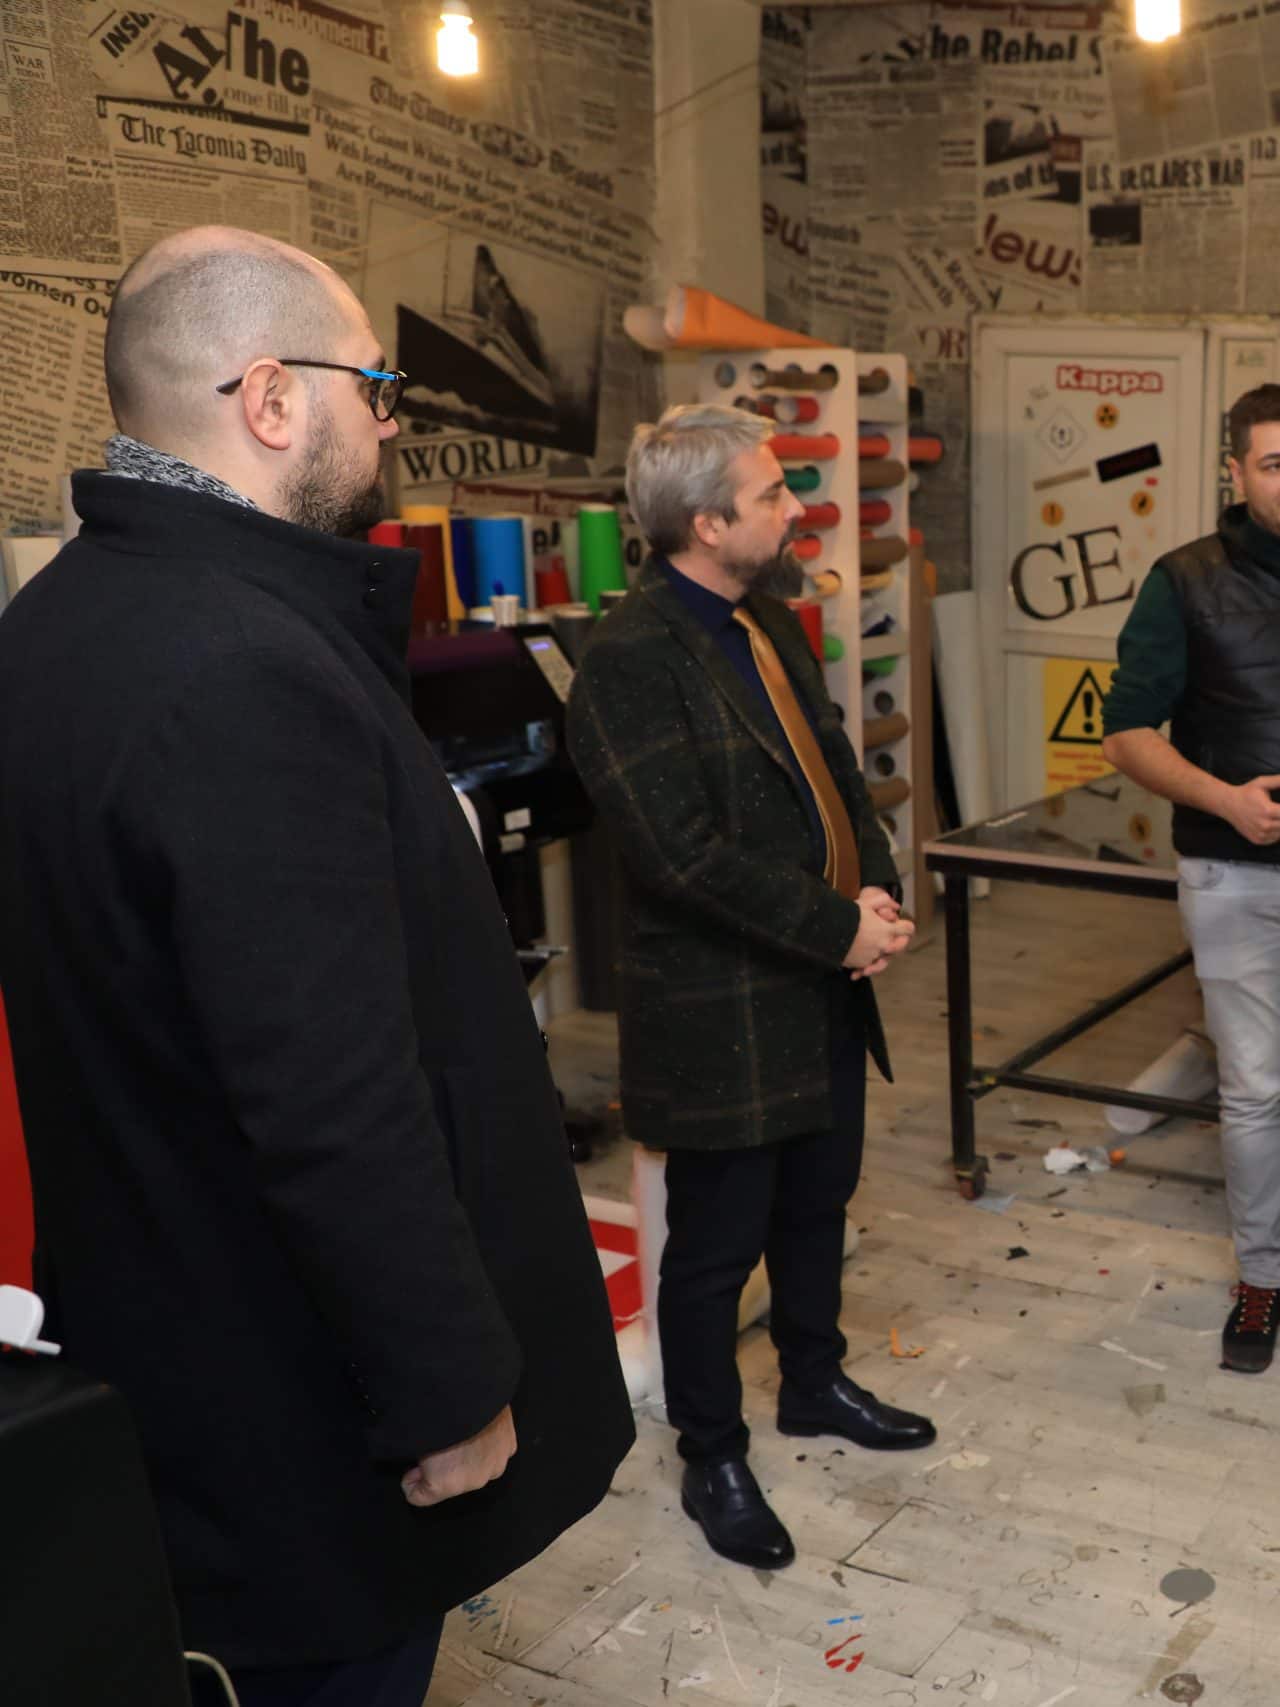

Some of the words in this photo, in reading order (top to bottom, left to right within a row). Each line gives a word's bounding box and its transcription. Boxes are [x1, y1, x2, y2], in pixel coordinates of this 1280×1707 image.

[12, 54, 45, 70] WAR
[117, 112, 166, 147] The
[168, 124, 247, 161] Laconia
[250, 137, 308, 175] Daily
[1208, 156, 1246, 187] WAR
[1055, 364, 1163, 397] Kappa
[400, 436, 542, 482] WORLD
